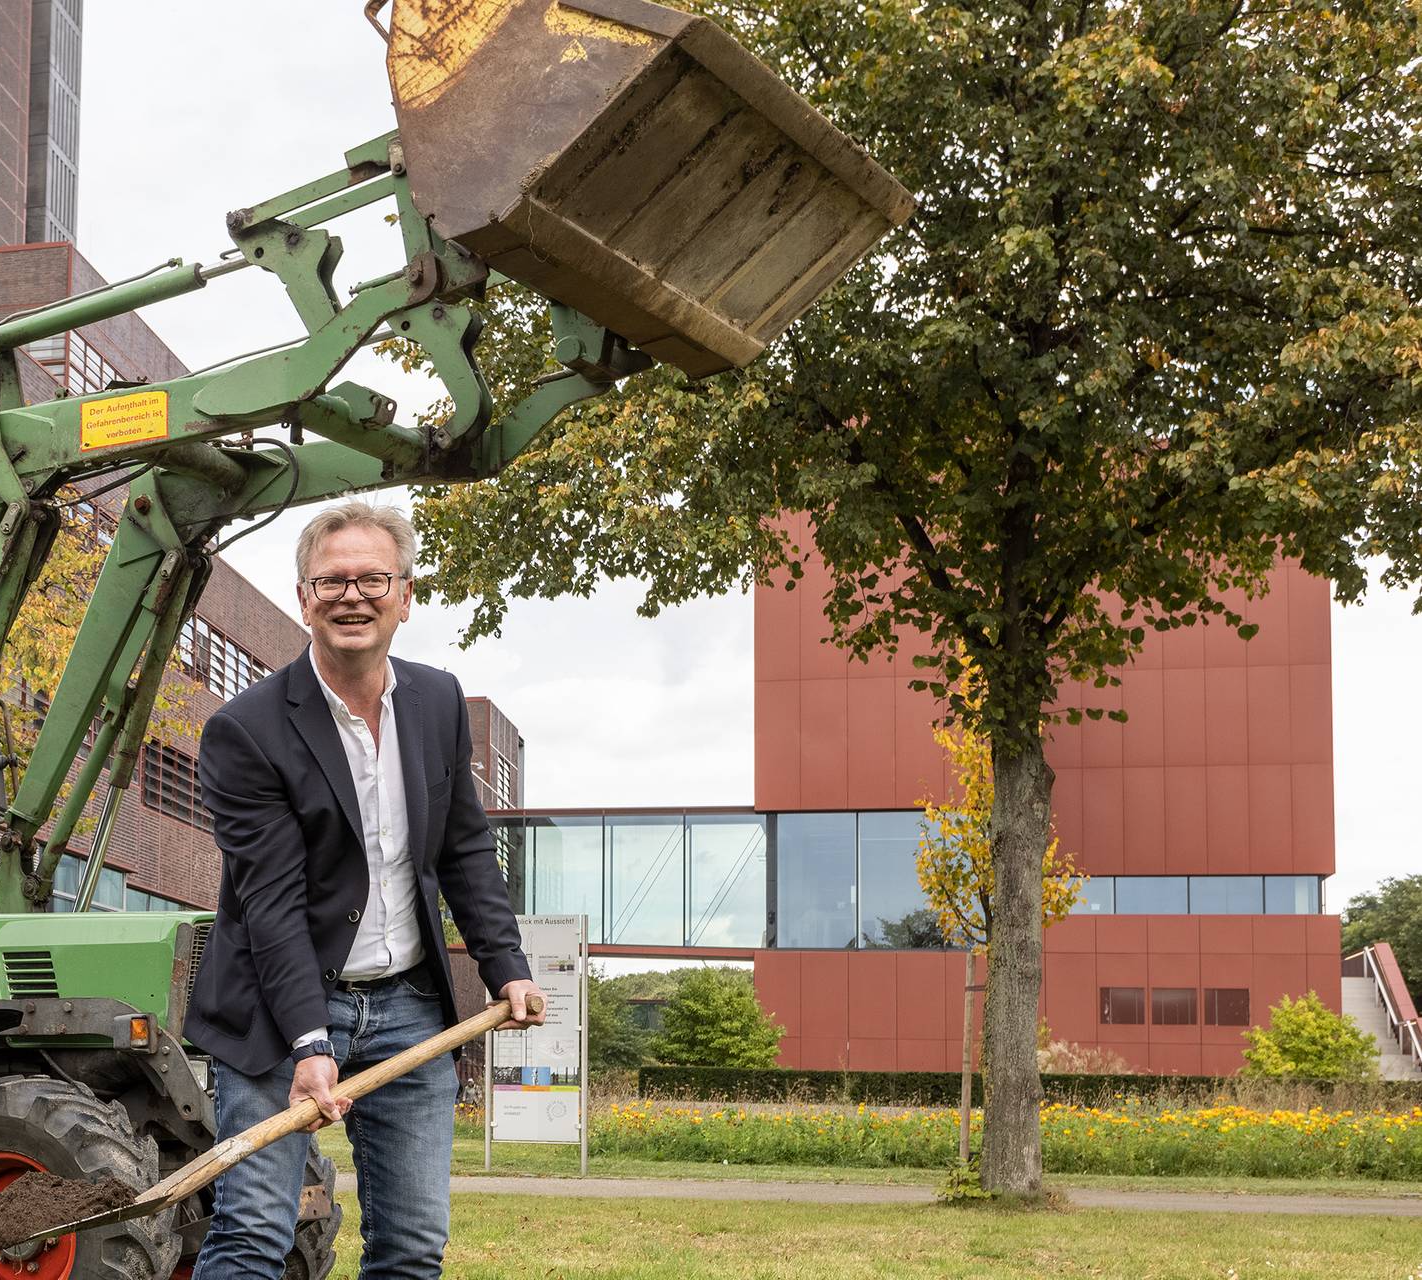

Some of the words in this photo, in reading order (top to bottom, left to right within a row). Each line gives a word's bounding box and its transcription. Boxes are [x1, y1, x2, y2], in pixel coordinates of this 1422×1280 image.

[89, 408, 104, 417] Der
[106, 400, 148, 413] Aufenthalt
[149, 397, 159, 405] im
[86, 413, 151, 430] Gefahrenbereich
[106, 426, 142, 439] verboten
